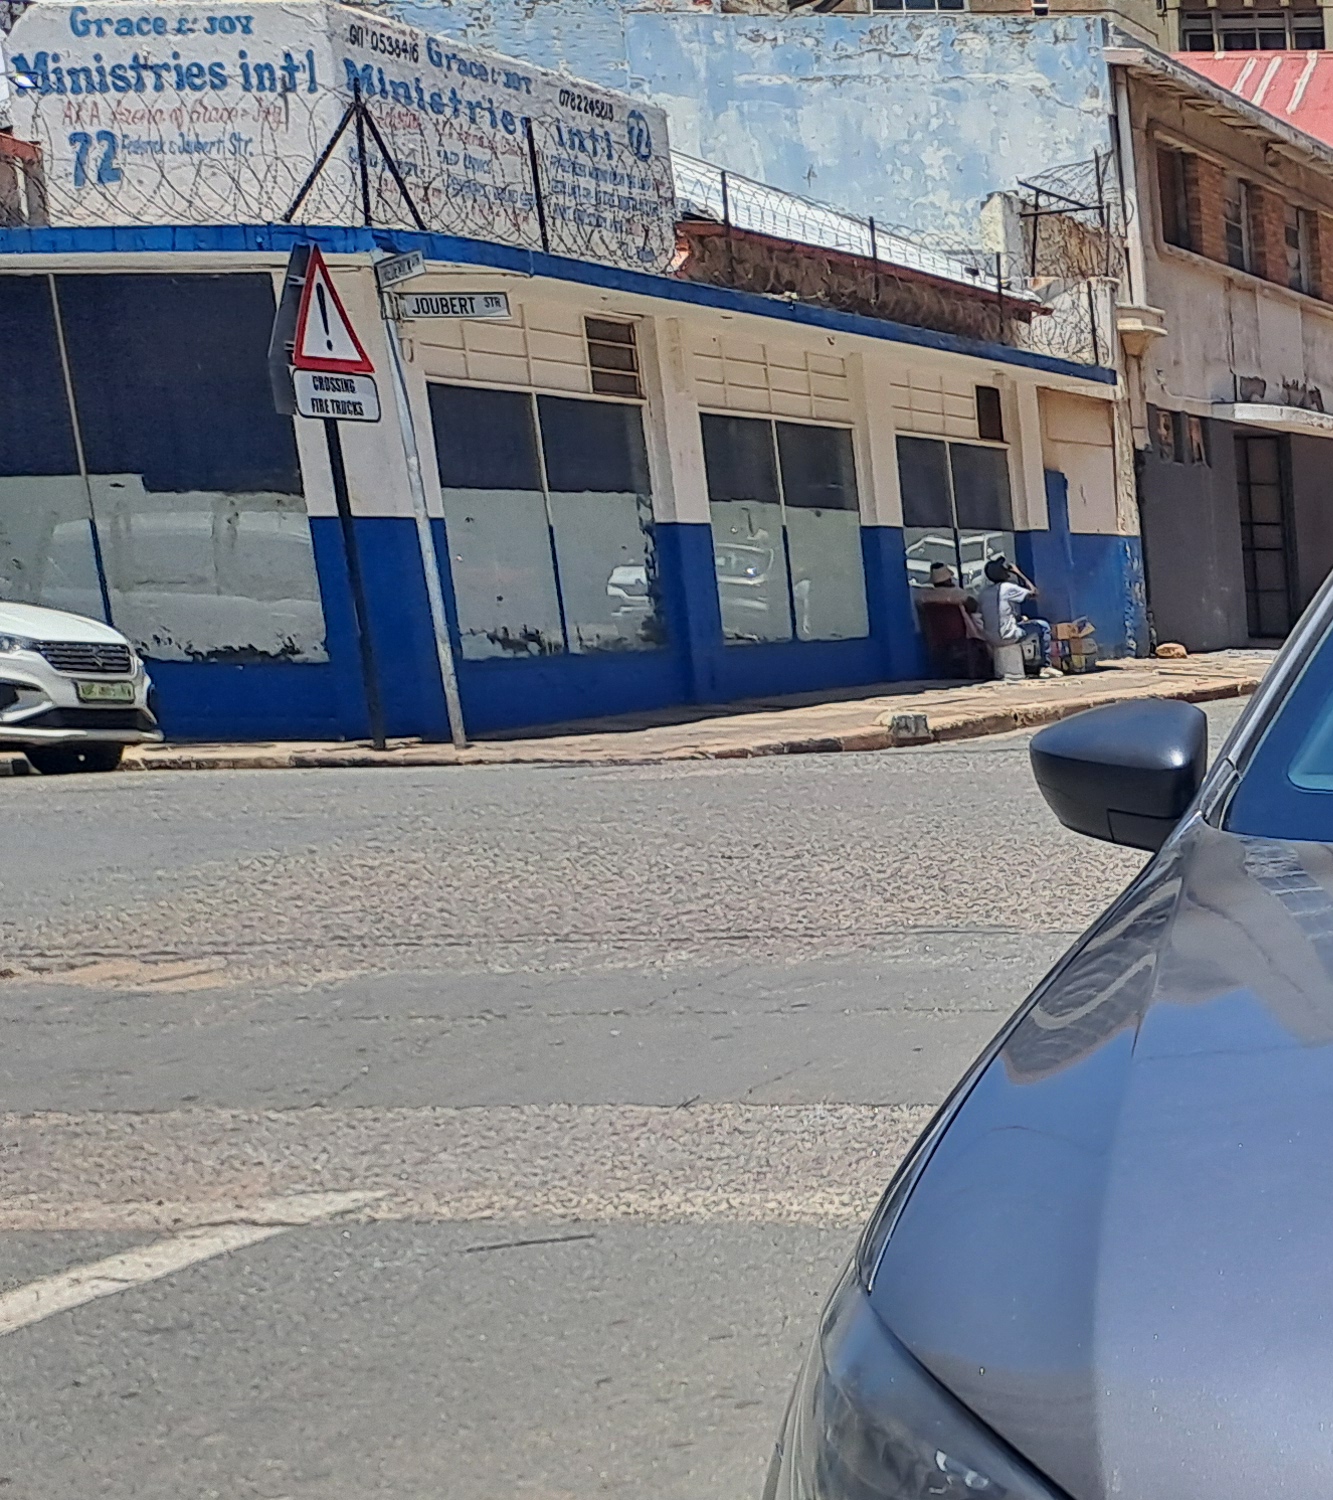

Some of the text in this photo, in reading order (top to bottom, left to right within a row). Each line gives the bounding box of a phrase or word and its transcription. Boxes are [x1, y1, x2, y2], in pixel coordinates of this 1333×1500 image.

[69, 6, 168, 38] Grace
[11, 50, 230, 95] Ministries
[68, 130, 124, 190] 72
[412, 296, 502, 316] JOUBERT STR
[312, 374, 357, 393] CROSSING
[311, 396, 364, 417] FIRE TRUCKS
